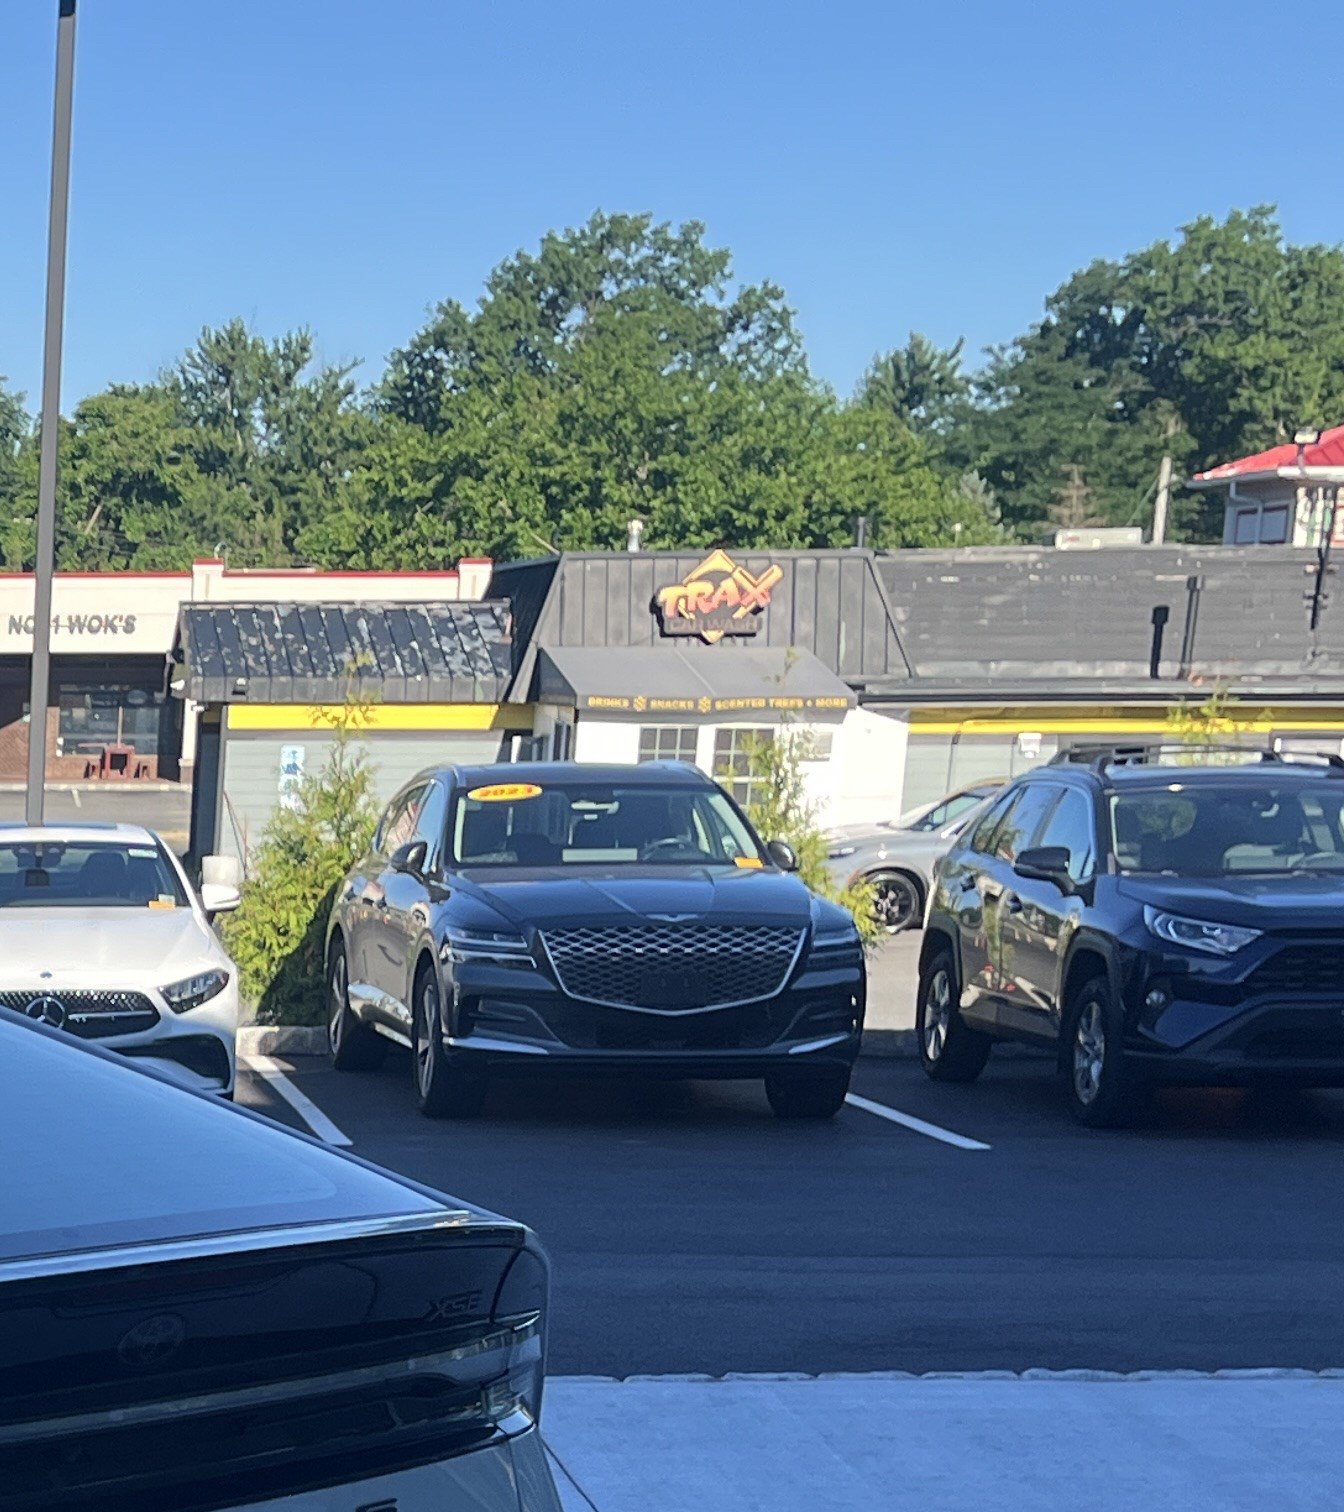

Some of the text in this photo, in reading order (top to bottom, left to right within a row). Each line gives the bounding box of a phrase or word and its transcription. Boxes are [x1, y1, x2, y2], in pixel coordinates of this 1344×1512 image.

[658, 564, 784, 619] TRAX
[67, 614, 137, 635] WOK'S
[815, 697, 848, 708] MORE
